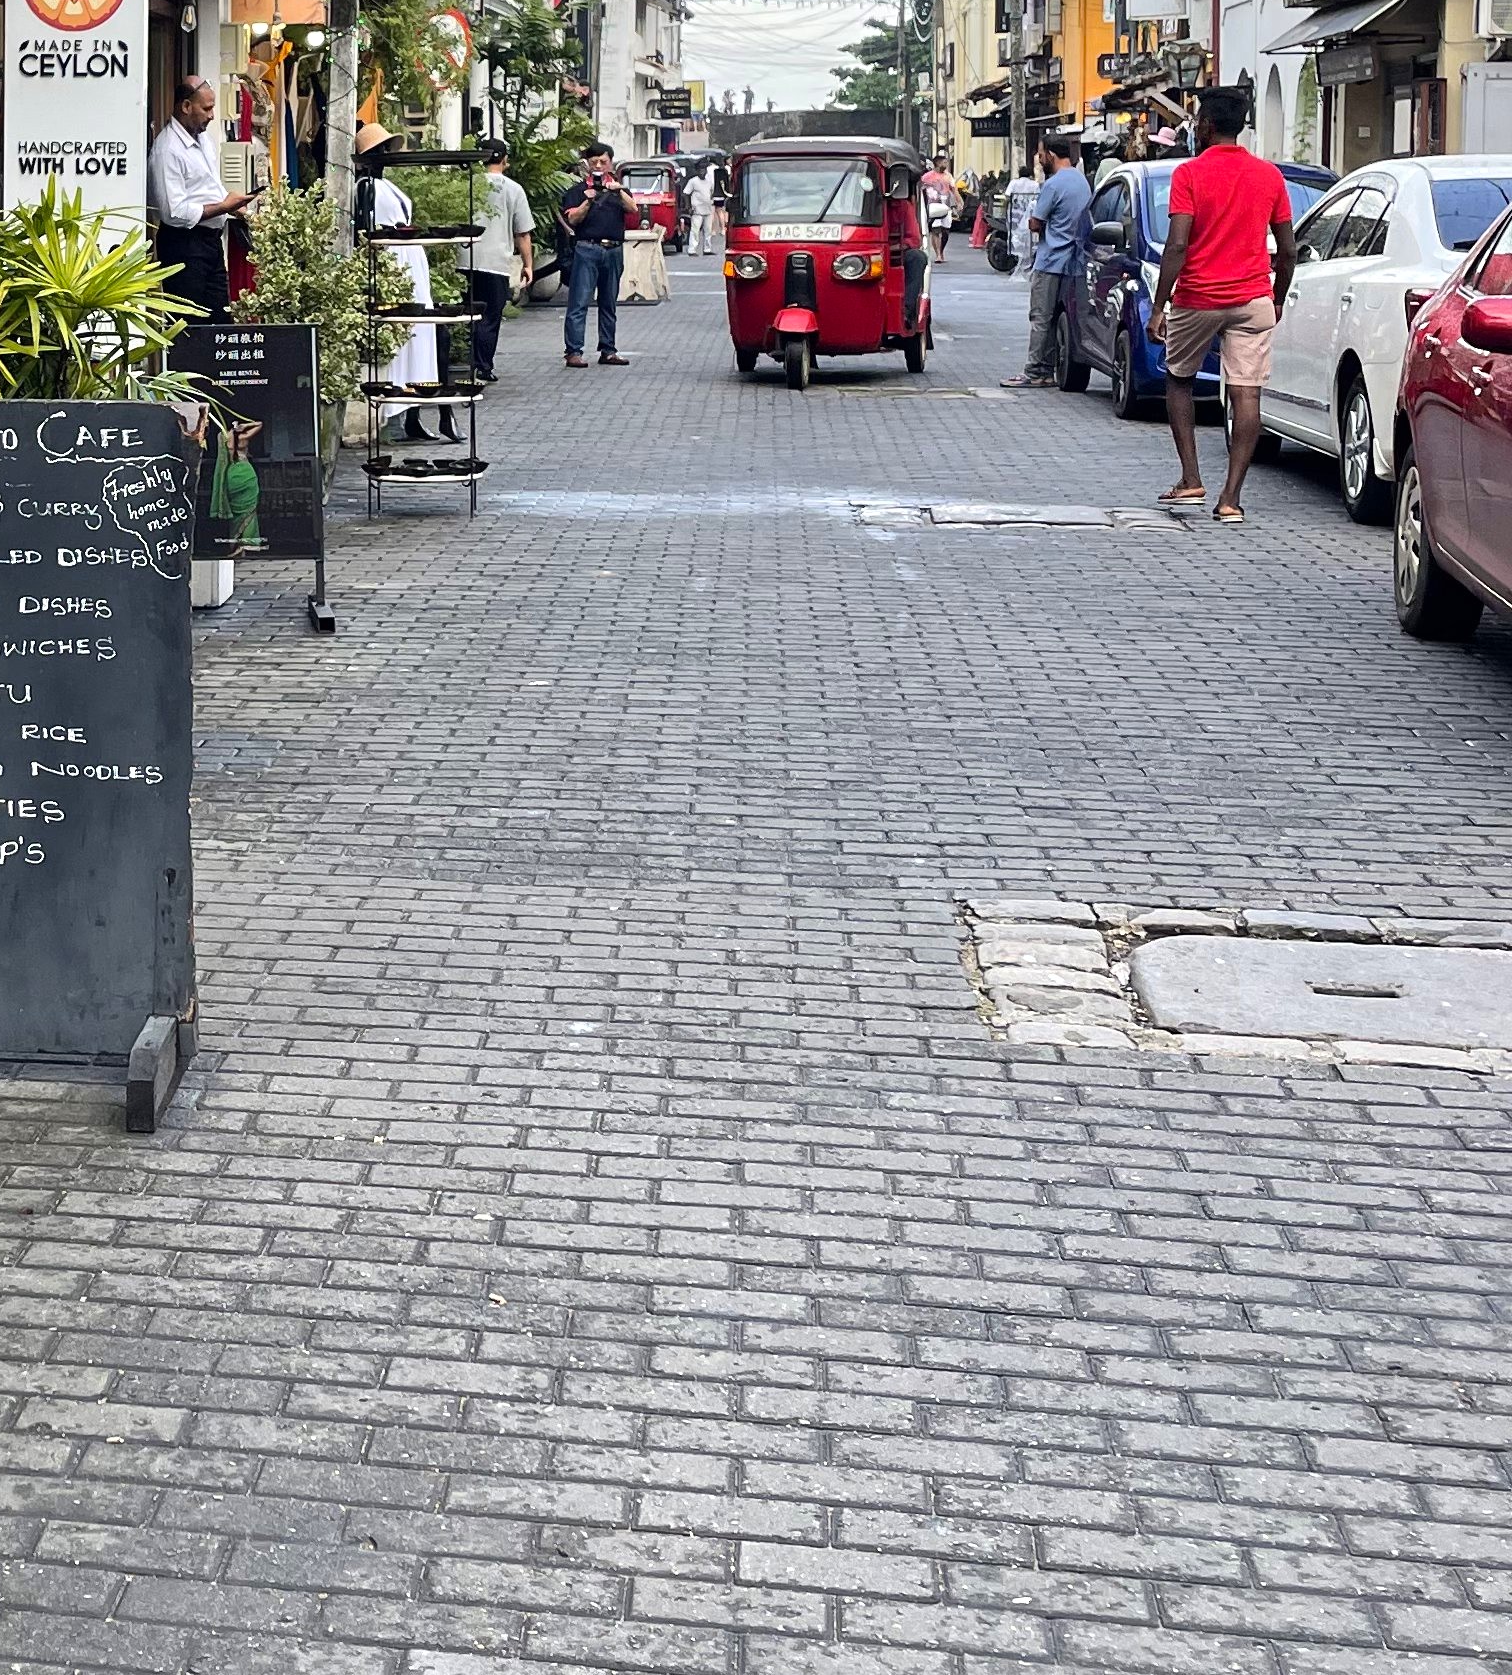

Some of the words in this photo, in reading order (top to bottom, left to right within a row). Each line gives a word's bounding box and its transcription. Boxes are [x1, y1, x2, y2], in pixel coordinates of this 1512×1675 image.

[34, 40, 82, 52] MADE
[94, 40, 112, 52] IN
[19, 54, 128, 77] CEYLON
[18, 141, 128, 155] HANDCRAFTED
[19, 157, 65, 175] WITH
[75, 157, 128, 175] LOVE
[37, 411, 144, 457] CAFE
[17, 499, 102, 530] CURRY
[127, 498, 170, 520] home
[147, 508, 188, 532] made
[57, 546, 148, 569] DISHES
[19, 596, 113, 618] DISHES
[21, 724, 87, 744] RICE
[31, 761, 164, 784] NOODLES
